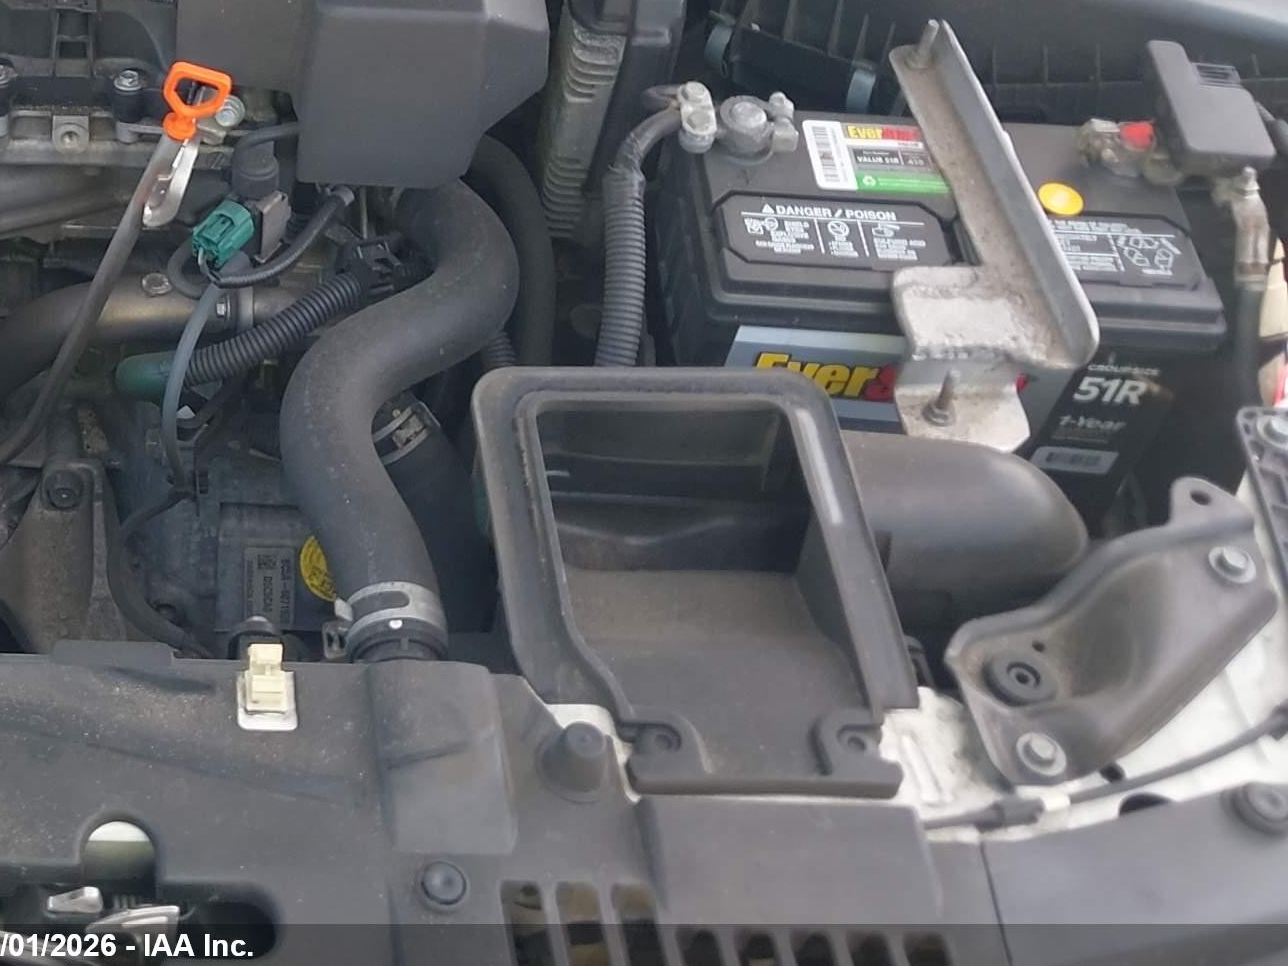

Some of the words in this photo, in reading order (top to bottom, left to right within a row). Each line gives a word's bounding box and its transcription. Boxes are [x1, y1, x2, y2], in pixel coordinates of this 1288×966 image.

[775, 204, 832, 218] DANGER
[845, 209, 897, 221] POISON
[1073, 376, 1147, 405] 51R
